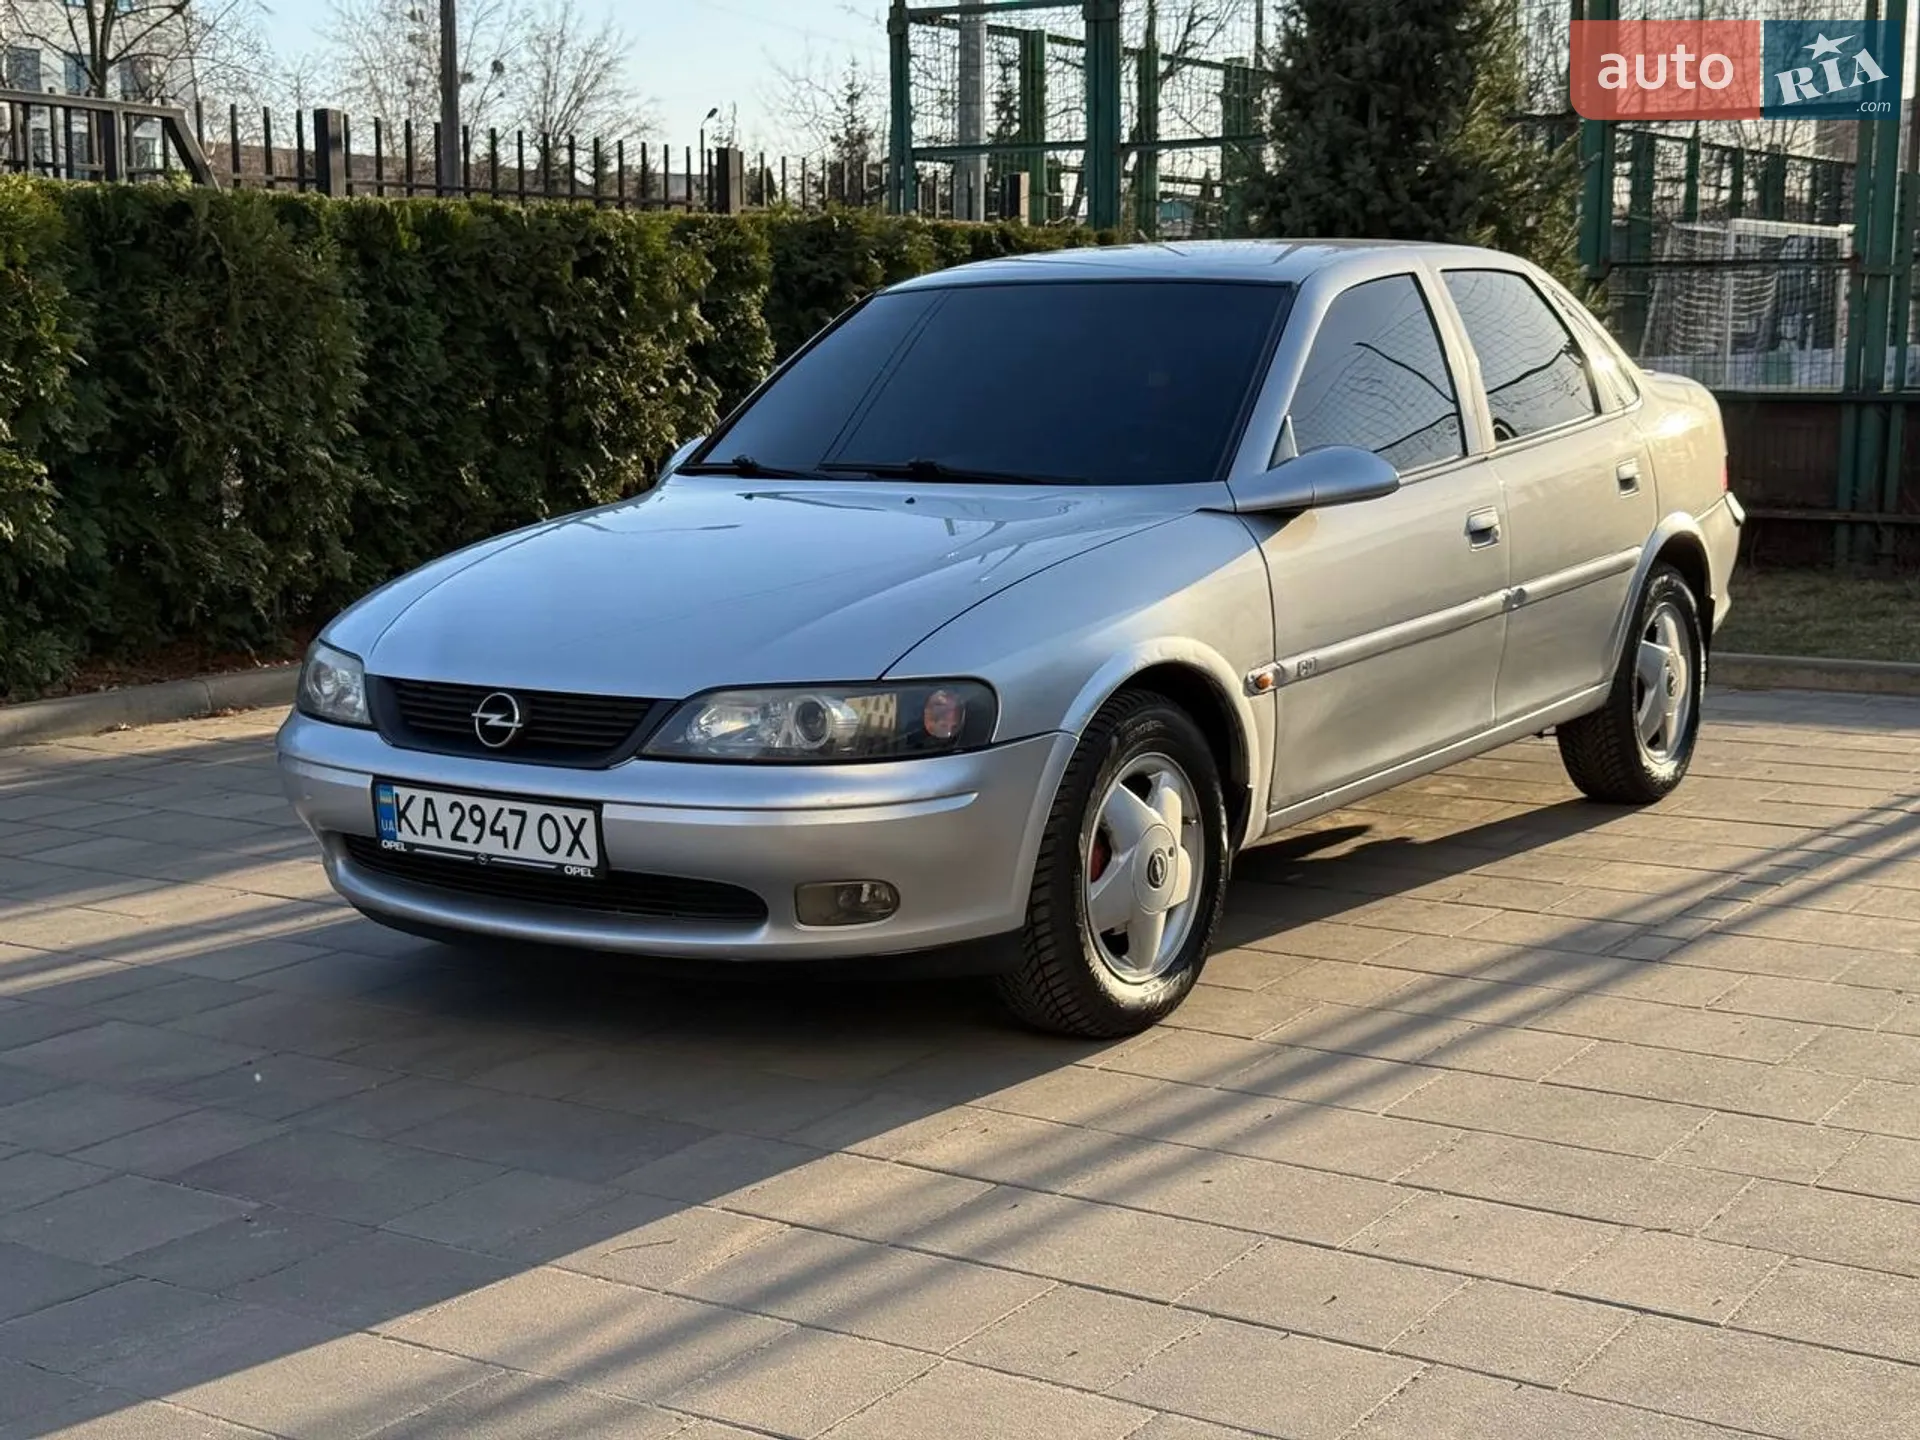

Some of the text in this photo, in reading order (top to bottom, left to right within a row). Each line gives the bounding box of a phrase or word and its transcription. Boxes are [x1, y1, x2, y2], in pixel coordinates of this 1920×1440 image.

[381, 819, 395, 832] UA
[395, 792, 590, 860] KA 2947 OX
[381, 839, 407, 852] OPEL
[564, 865, 594, 878] OPEL
